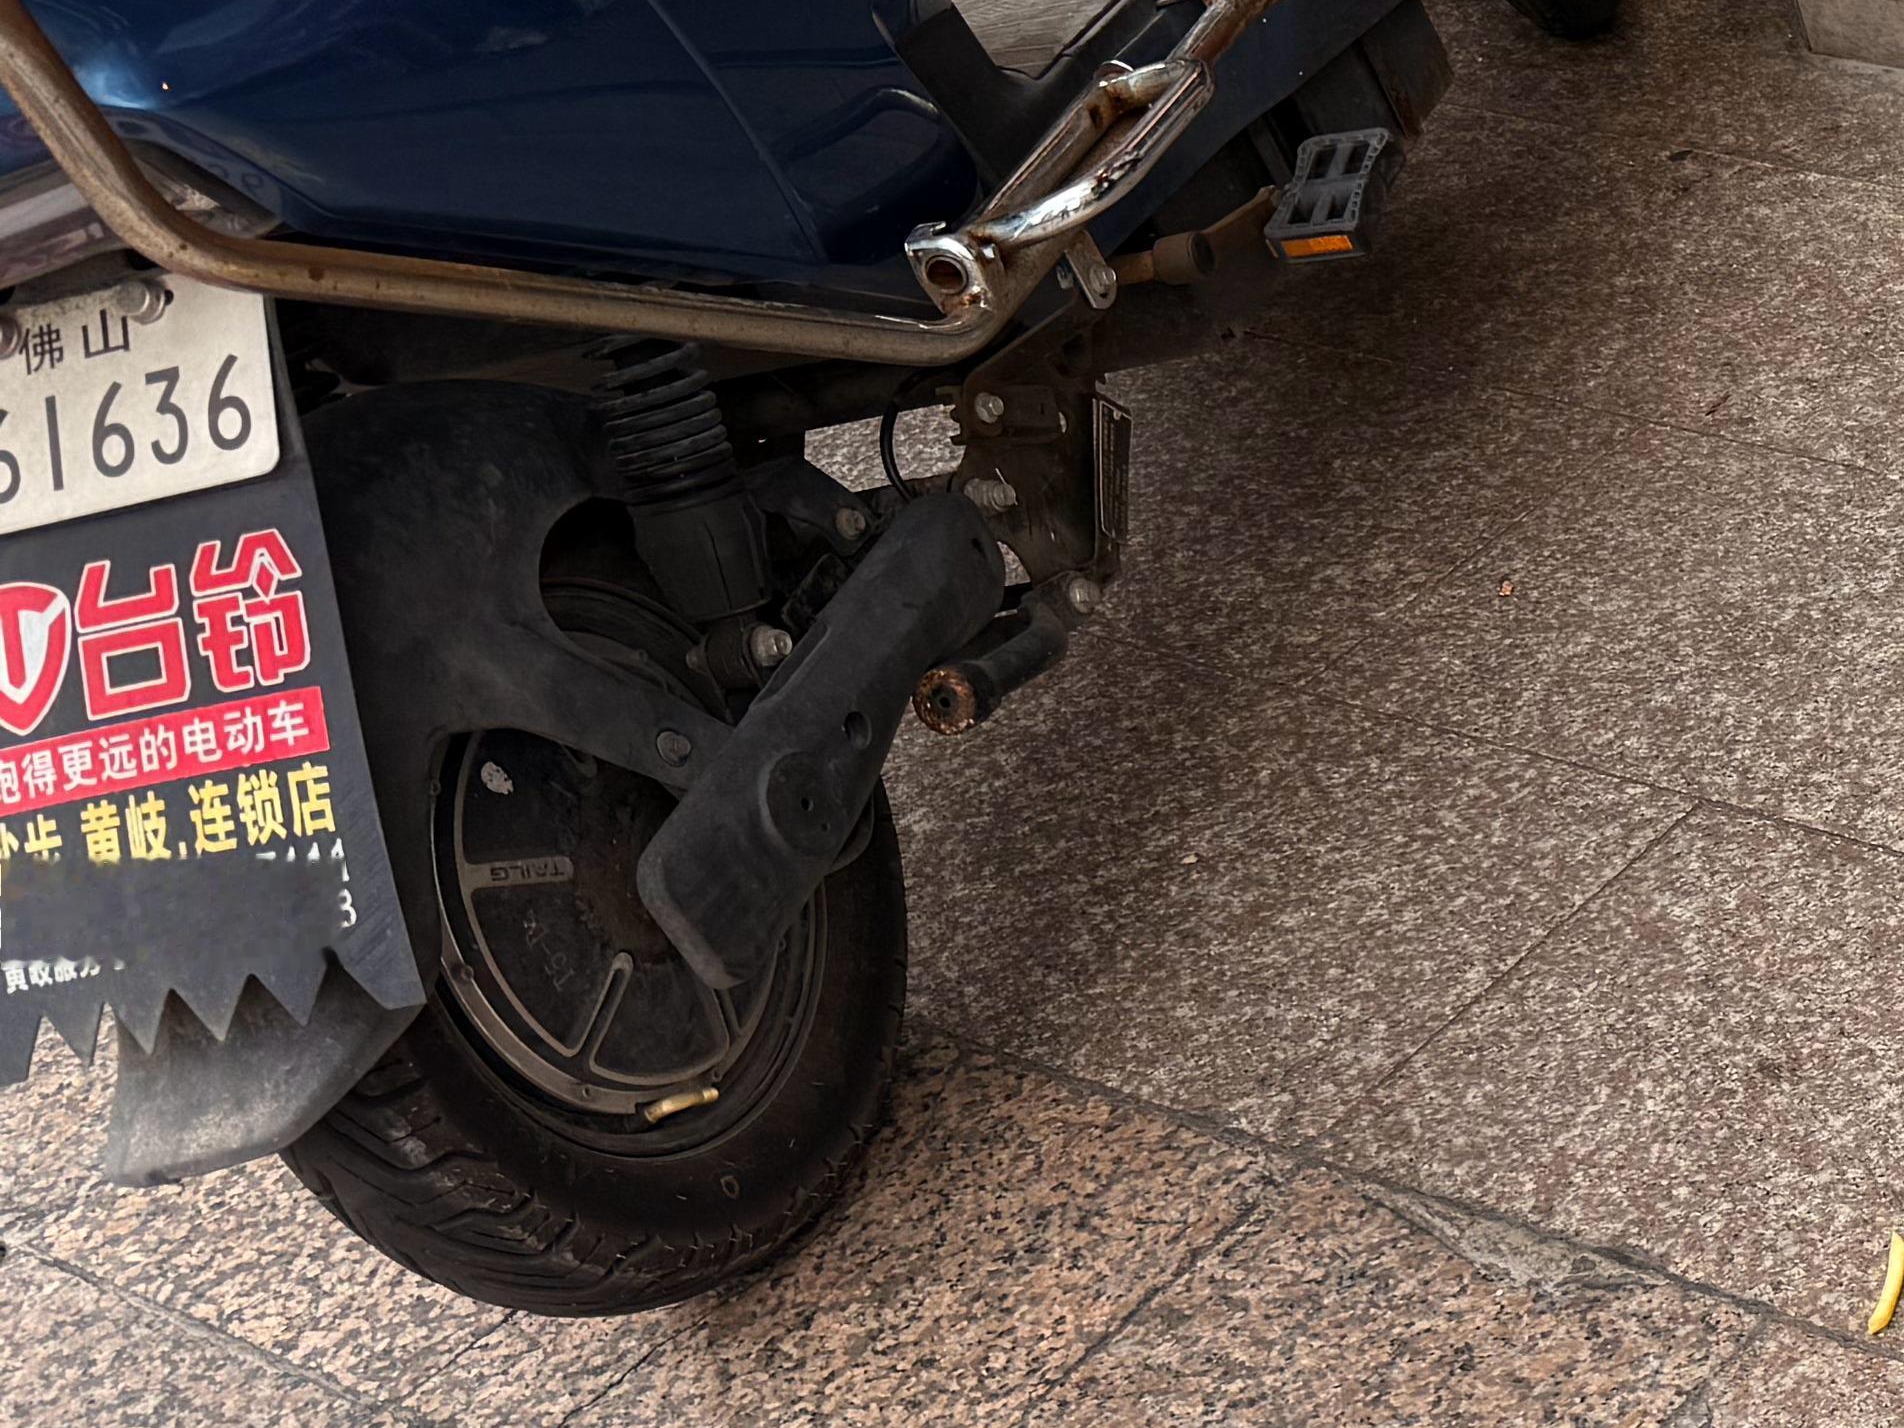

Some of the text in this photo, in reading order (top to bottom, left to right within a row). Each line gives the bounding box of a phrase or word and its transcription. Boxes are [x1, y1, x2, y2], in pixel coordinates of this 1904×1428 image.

[19, 308, 131, 376] 佛山
[74, 528, 312, 722] 台铃
[490, 860, 565, 882] TAILG
